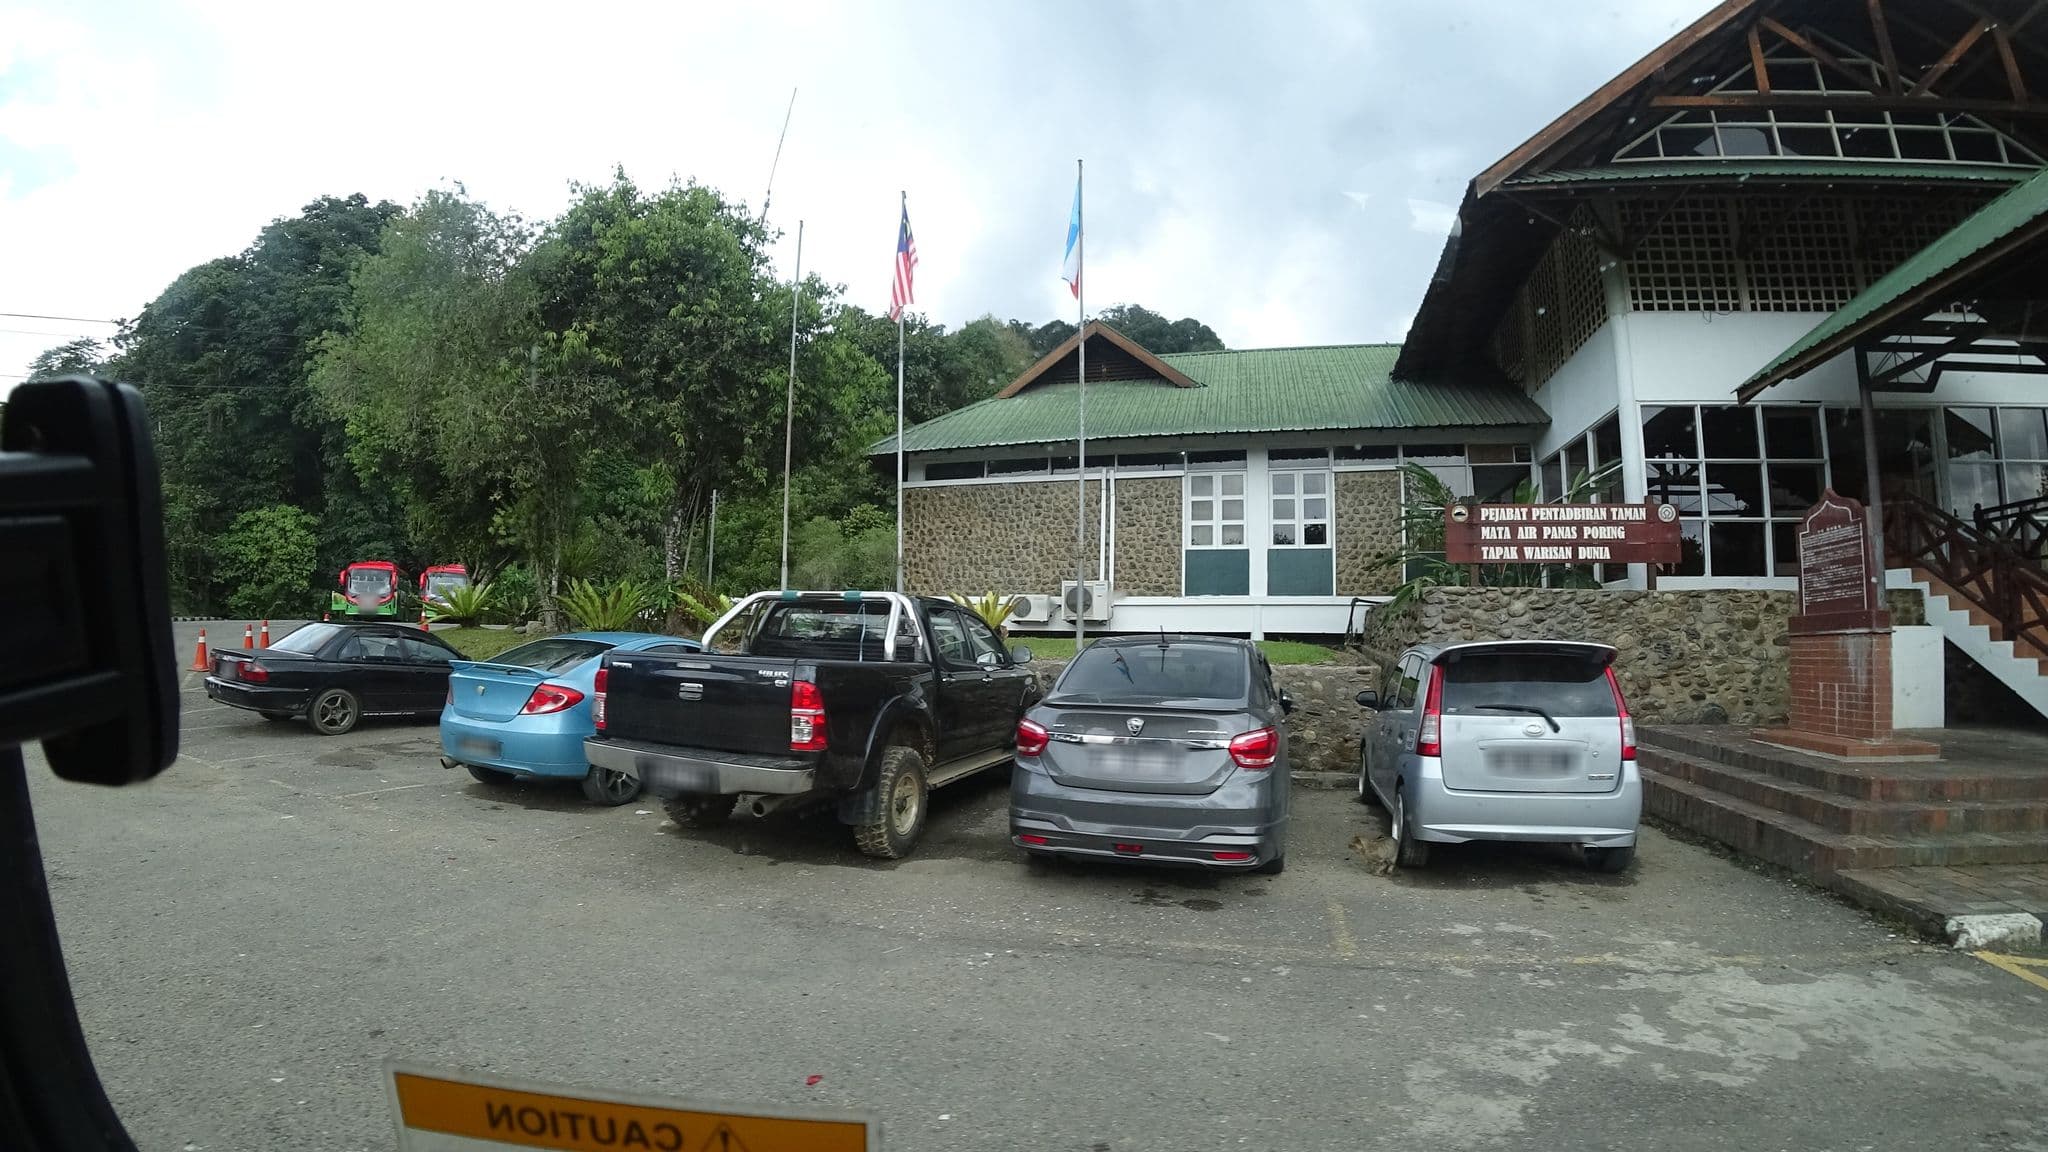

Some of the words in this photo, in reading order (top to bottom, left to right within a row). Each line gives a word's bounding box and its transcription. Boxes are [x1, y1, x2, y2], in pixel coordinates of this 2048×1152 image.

[1480, 508, 1528, 522] PEJABAT
[1532, 508, 1607, 520] PENTADBIRAN
[1611, 508, 1646, 520] TAMAN
[1481, 527, 1511, 539] MATA
[1517, 527, 1537, 539] AIR
[1543, 527, 1577, 539] PANAS
[1583, 526, 1625, 539] PORING
[1481, 547, 1518, 559] TAPAK
[1524, 547, 1572, 559] WARISAN
[1578, 547, 1611, 559] DUNIA
